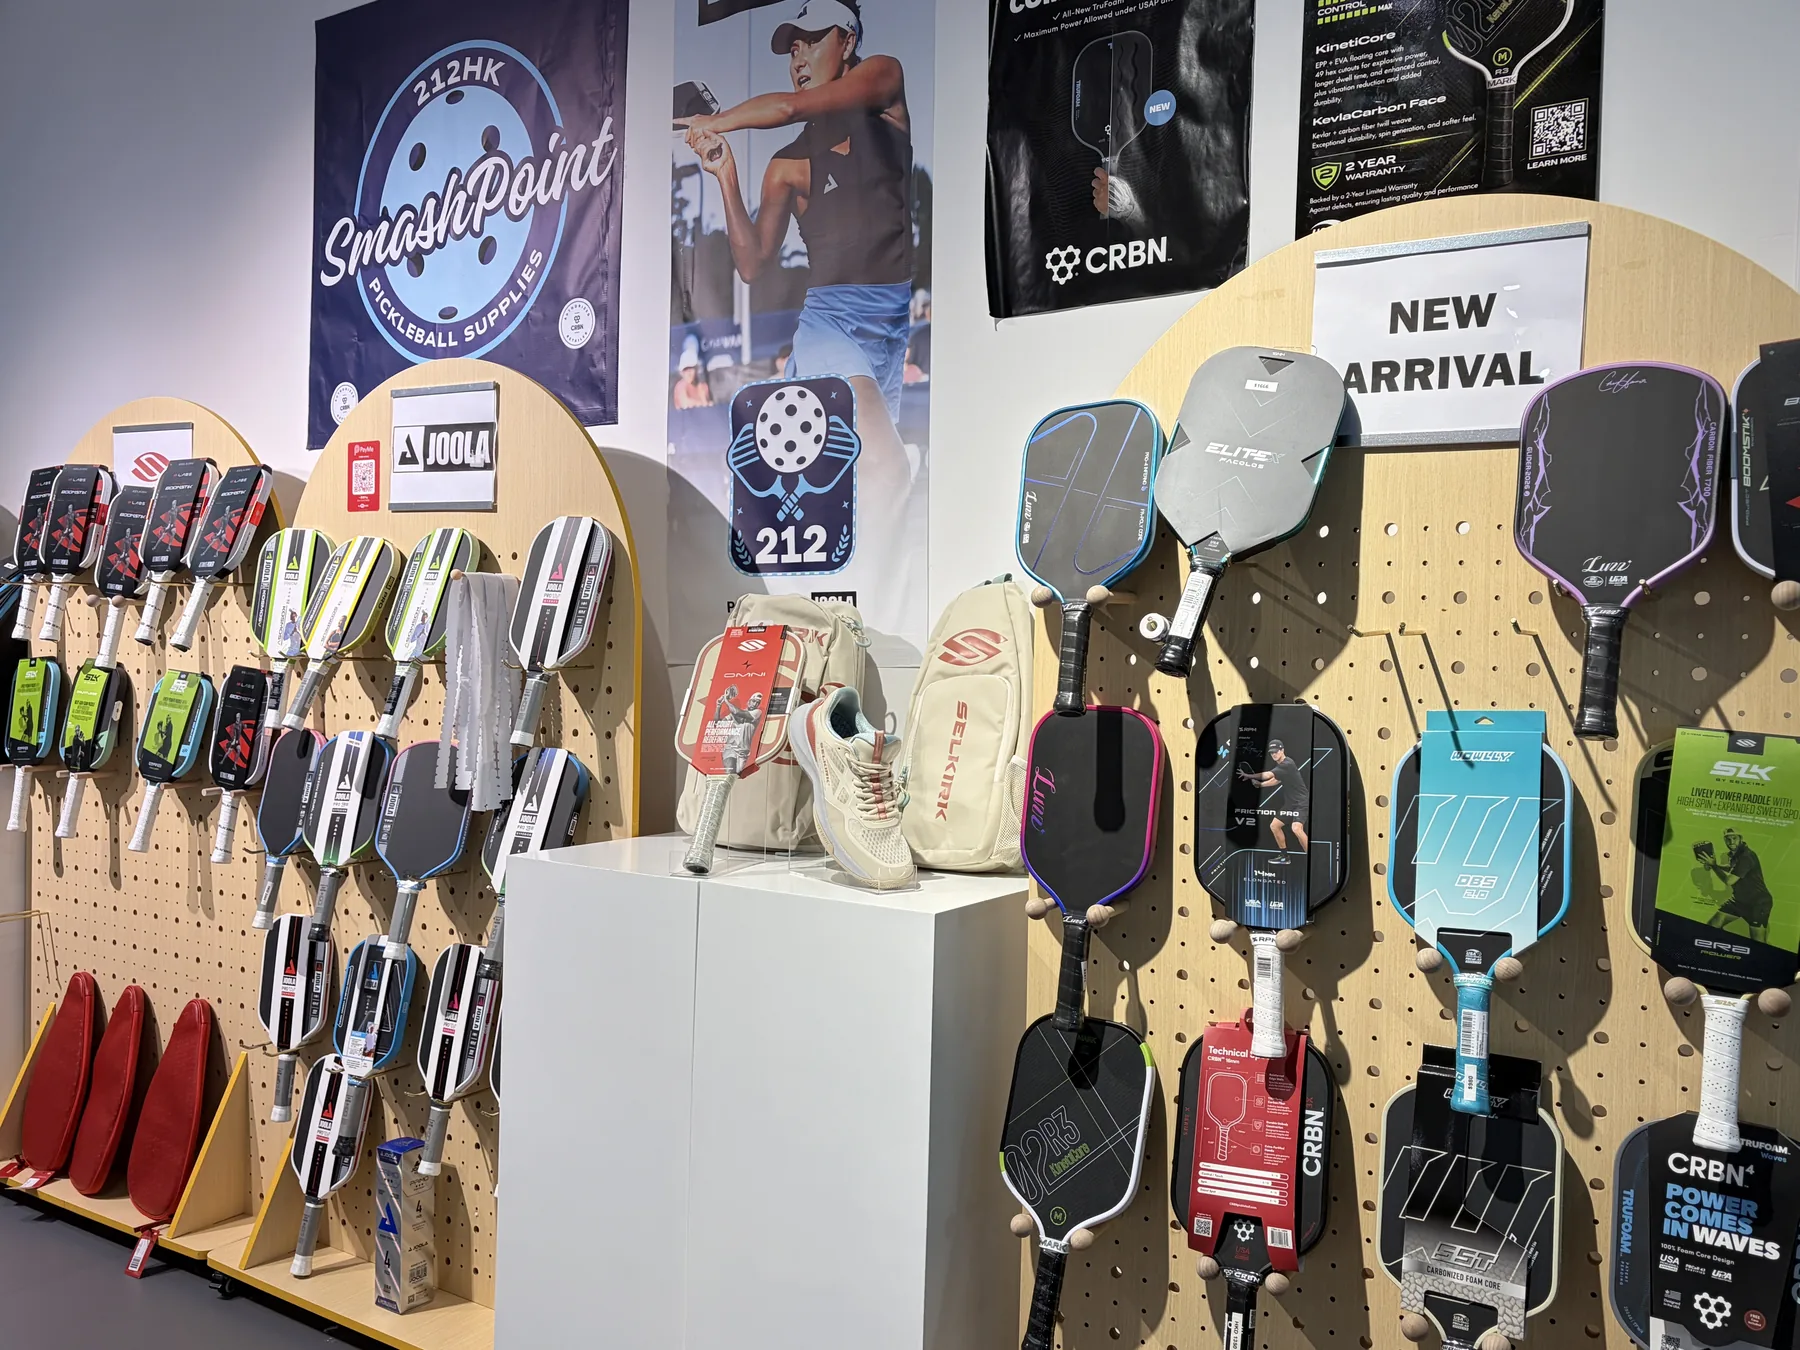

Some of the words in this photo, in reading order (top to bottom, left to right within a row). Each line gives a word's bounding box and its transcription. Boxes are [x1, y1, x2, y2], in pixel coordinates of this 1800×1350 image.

[1062, 7, 1091, 19] All-New
[1093, 0, 1125, 11] TruFoam
[1317, 0, 1367, 16] CONTROL
[1378, 3, 1393, 12] MAX
[1023, 26, 1058, 39] Maximum
[1060, 20, 1083, 31] Power
[1084, 11, 1113, 24] Allowed
[1115, 6, 1137, 17] under
[1315, 31, 1396, 55] KinetiCore
[1315, 61, 1328, 69] EPP
[1334, 58, 1349, 66] EVA
[1350, 52, 1373, 63] floating
[1390, 45, 1404, 54] with
[1325, 68, 1337, 76] hex
[1338, 64, 1360, 74] cutouts
[1361, 62, 1371, 70] for
[1372, 56, 1403, 68] explosive
[1404, 51, 1428, 62] power,
[1498, 52, 1508, 62] M
[413, 56, 506, 107] 212HK
[1314, 80, 1334, 91] longer
[1335, 75, 1352, 84] dwell
[1353, 72, 1369, 80] time,
[1370, 69, 1383, 77] and
[1384, 61, 1416, 74] enhanced
[1416, 57, 1441, 69] control,
[1487, 75, 1516, 88] MARK
[1495, 67, 1509, 75] R3
[1313, 89, 1327, 99] plus
[1328, 84, 1356, 95] vibration
[1356, 78, 1386, 89] reduction
[1386, 74, 1399, 83] and
[1400, 70, 1422, 81] added
[1149, 102, 1171, 114] NEW
[1312, 103, 1407, 127] KevlaCarbon
[1409, 95, 1447, 109] Face
[1311, 138, 1347, 150] Exceptional
[1347, 132, 1377, 144] durability,
[1378, 130, 1391, 140] spin
[1392, 124, 1426, 138] generation,
[1427, 121, 1441, 130] and
[1442, 117, 1461, 126] softer
[1462, 113, 1477, 123] feel.
[1312, 131, 1332, 141] Kevlar
[1338, 125, 1361, 135] carbon
[1361, 122, 1376, 131] fiber
[1376, 119, 1390, 128] twill
[1391, 116, 1413, 125] weave
[1345, 162, 1355, 172] 2
[1357, 154, 1396, 170] YEAR
[1527, 157, 1559, 170] LEARN
[1561, 154, 1588, 165] MORE
[1320, 168, 1333, 179] 2
[1345, 165, 1406, 181] WARRANTY
[320, 116, 618, 287] SmashPoint
[1309, 195, 1331, 205] Backed
[1332, 194, 1340, 204] by
[1345, 190, 1365, 200] 2-Year
[1366, 186, 1387, 196] Limited
[1388, 182, 1419, 193] Warranty
[1309, 206, 1331, 216] Against
[1332, 202, 1354, 211] defects,
[1355, 197, 1381, 208] ensuring
[1381, 193, 1401, 204] lasting
[1401, 190, 1423, 202] quality
[1423, 187, 1437, 196] and
[1437, 182, 1479, 196] performance
[368, 277, 458, 348] PICKLEBALL
[463, 248, 543, 338] SUPPLIES
[1389, 293, 1497, 334] NEW
[1344, 351, 1545, 394] ARRIVAL
[1707, 422, 1717, 451] CARBON
[427, 430, 491, 466] JOOLA
[1742, 412, 1752, 487] BOOMSTIK
[1705, 453, 1715, 475] FIBER
[1703, 477, 1711, 497] T700
[755, 525, 828, 564] 212
[263, 561, 271, 582] JOOLA
[407, 563, 418, 586] JOOLA
[546, 583, 562, 591] JOOLA
[583, 577, 593, 598] JOOLA
[84, 674, 101, 682] SLK
[705, 728, 741, 736] PERFORMANCE
[935, 700, 969, 822] SELKIRK
[1710, 761, 1776, 781] SLK
[387, 795, 396, 816] JOOLA
[1676, 796, 1694, 807] HIGH
[1695, 798, 1712, 809] SPIN
[1718, 801, 1755, 815] EXPANDED
[1756, 805, 1782, 818] SWEET
[1784, 809, 1800, 820] SPO
[1691, 787, 1714, 799] LIVELY
[1715, 790, 1741, 802] POWER
[1743, 794, 1771, 806] PADDLE
[1772, 796, 1792, 808] WITH
[520, 815, 537, 824] JOOLA
[1235, 808, 1276, 816] FRICTION
[1235, 817, 1256, 826] V2
[1700, 950, 1742, 960] POWER
[474, 1008, 482, 1029] JOOLA
[1208, 1045, 1248, 1058] Technical
[1302, 1106, 1325, 1177] CRBN
[1740, 1138, 1790, 1155] TRUFOAM
[1760, 1152, 1787, 1163] Waves
[416, 1200, 422, 1212] 4
[1666, 1183, 1758, 1219] POWER
[1620, 1189, 1634, 1255] TRUFOAM
[1665, 1201, 1753, 1236] COMES
[413, 1242, 428, 1251] JOOLA
[1039, 1238, 1069, 1251] MARK
[1663, 1218, 1689, 1240] IN
[1692, 1224, 1781, 1260] WAVES
[384, 1251, 391, 1268] 4
[1431, 1241, 1498, 1272] SST
[1660, 1243, 1676, 1251] 100%
[1677, 1247, 1695, 1256] Foam
[1696, 1251, 1711, 1260] Core
[1712, 1255, 1735, 1266] Design
[1660, 1253, 1680, 1265] USA
[1234, 1271, 1259, 1283] CRBN
[1427, 1265, 1463, 1281] CARBONIZED
[1466, 1276, 1483, 1287] FOAM
[1485, 1280, 1501, 1291] CORE
[1712, 1269, 1732, 1280] UPA
